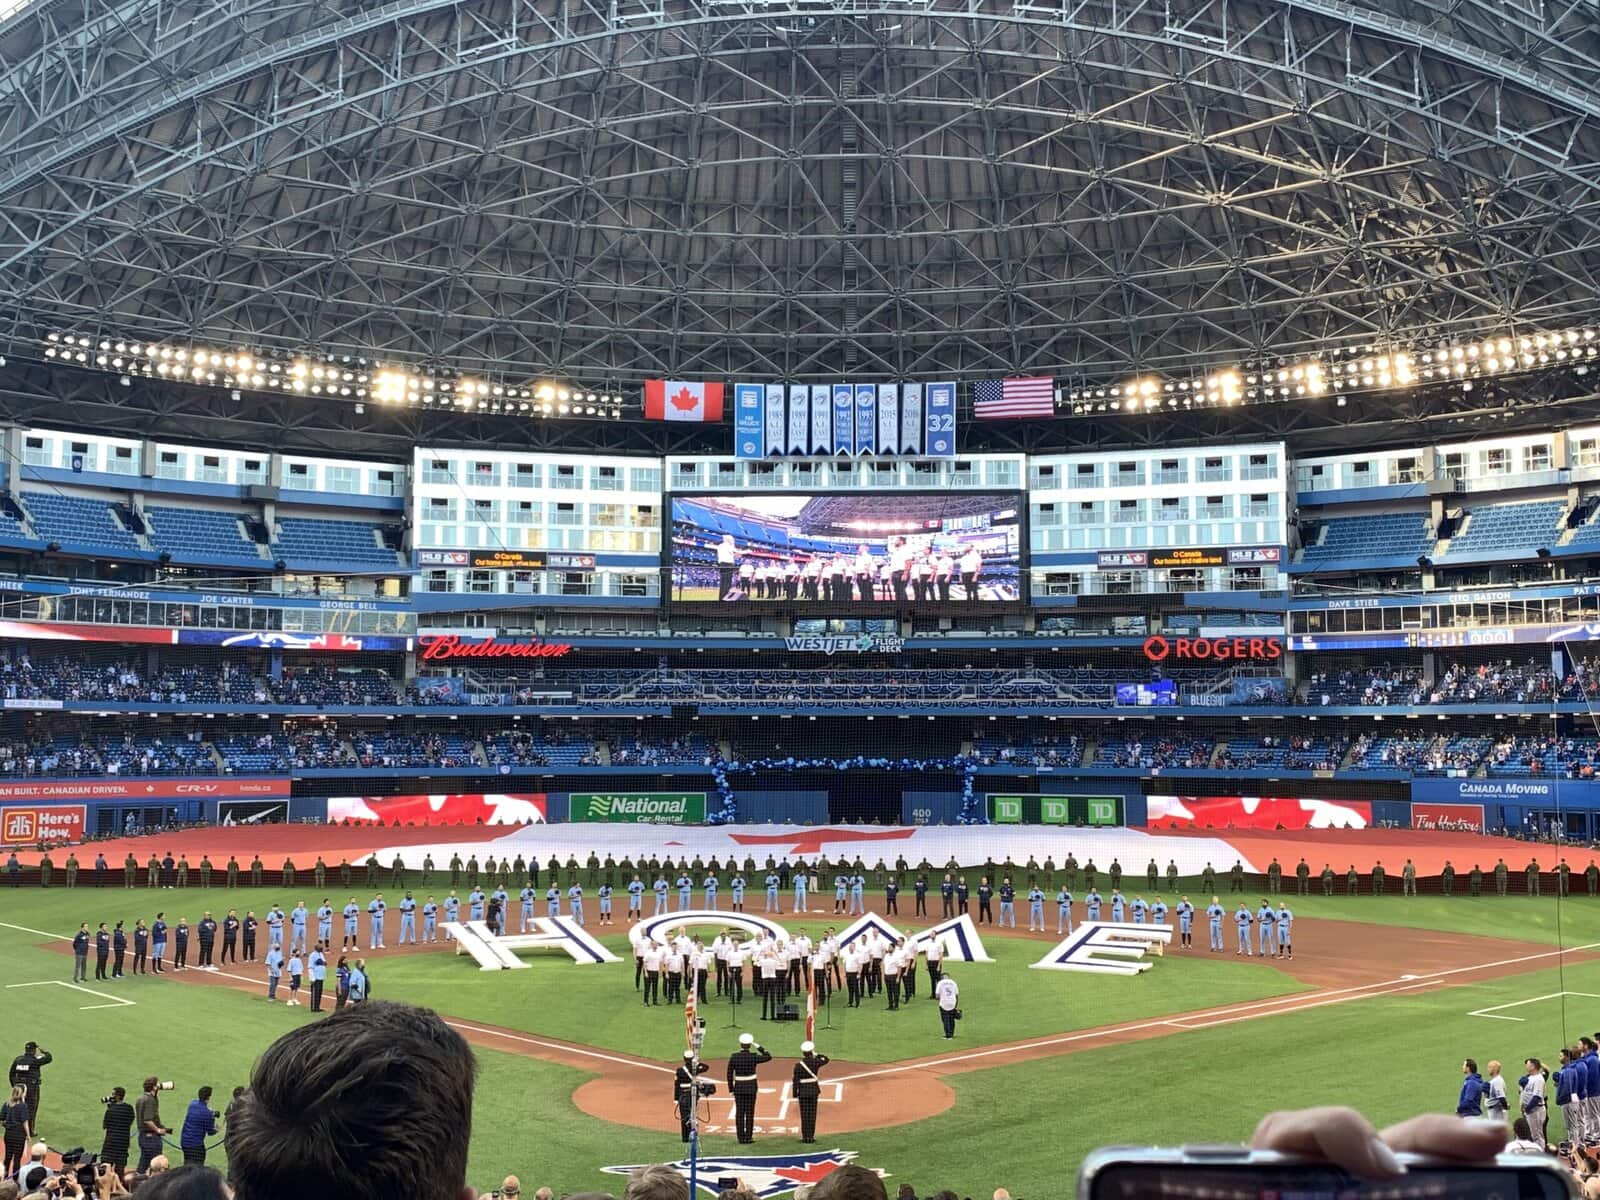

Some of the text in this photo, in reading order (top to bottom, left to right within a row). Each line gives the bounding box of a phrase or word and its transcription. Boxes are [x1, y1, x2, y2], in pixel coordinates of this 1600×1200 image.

[928, 414, 953, 432] 32
[98, 588, 151, 600] FERNANDEZ
[1473, 592, 1511, 601] GASTON
[1573, 586, 1590, 596] PAT
[200, 594, 254, 604] JOE CARTER
[320, 601, 377, 610] GEORGE BELL
[418, 634, 572, 660] Budweiser
[786, 637, 855, 654] WESTJET
[1176, 638, 1280, 658] ROGERS
[14, 787, 40, 795] BUILT.
[43, 786, 90, 794] CANADIAN
[92, 785, 128, 793] DRIVEN.
[176, 784, 218, 792] CR-V
[1460, 782, 1549, 794] CANADA MOVING
[912, 808, 932, 818] 400
[998, 802, 1019, 817] TD
[1044, 802, 1066, 818] TD
[1091, 804, 1113, 819] TD
[39, 812, 80, 825] Here's
[636, 814, 684, 823] Car Rental
[1416, 814, 1436, 829] Tim
[38, 826, 71, 838] How.
